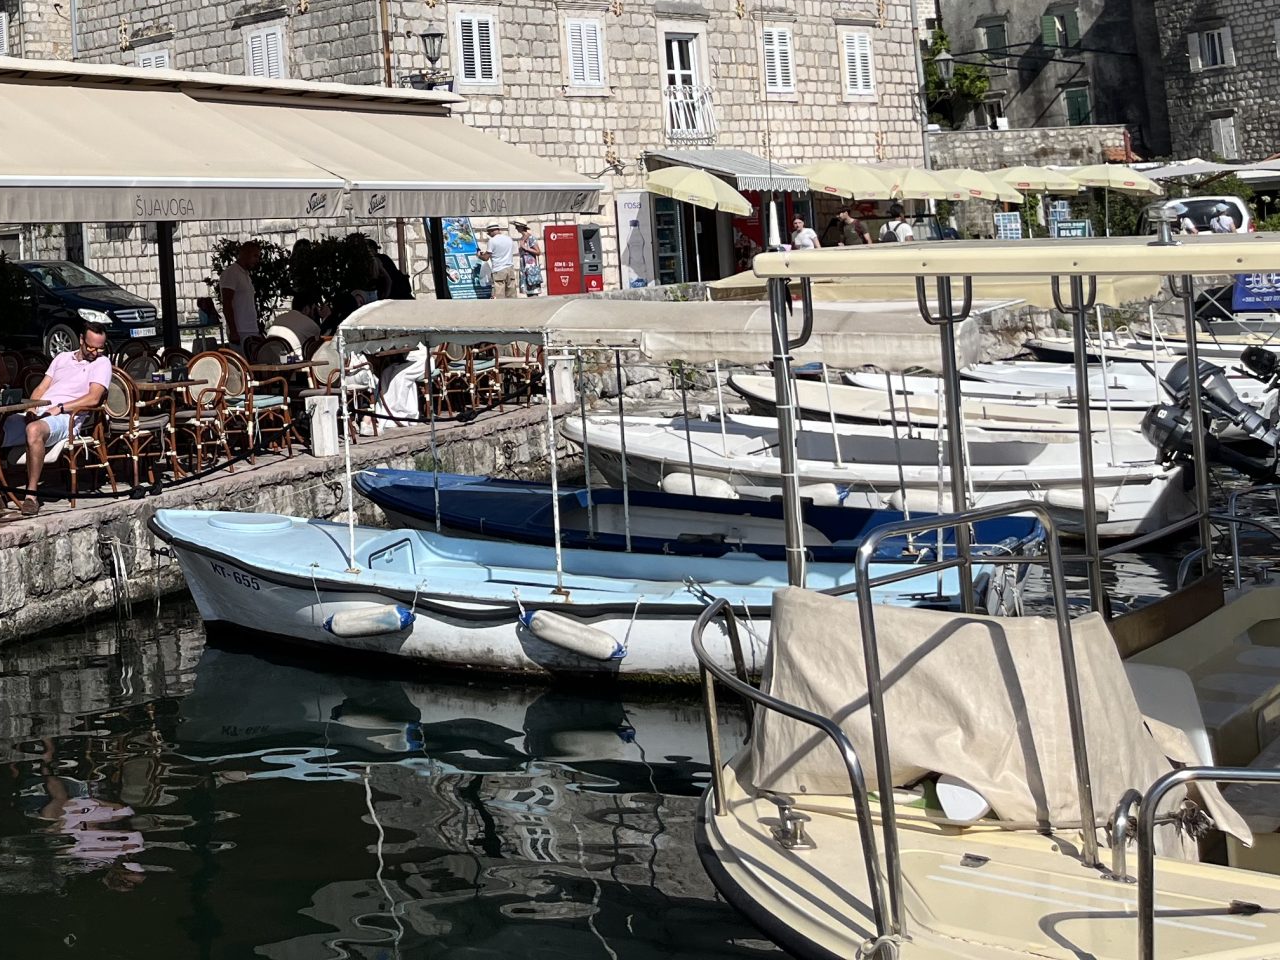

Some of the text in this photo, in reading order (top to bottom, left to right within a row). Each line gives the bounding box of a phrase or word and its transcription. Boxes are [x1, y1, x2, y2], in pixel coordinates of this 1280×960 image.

[135, 194, 195, 216] ŠIJAVOGA
[469, 196, 508, 213] ŠJAVOGA
[623, 201, 642, 209] rosa
[1060, 229, 1083, 237] BLUE
[210, 560, 261, 591] KT-655
